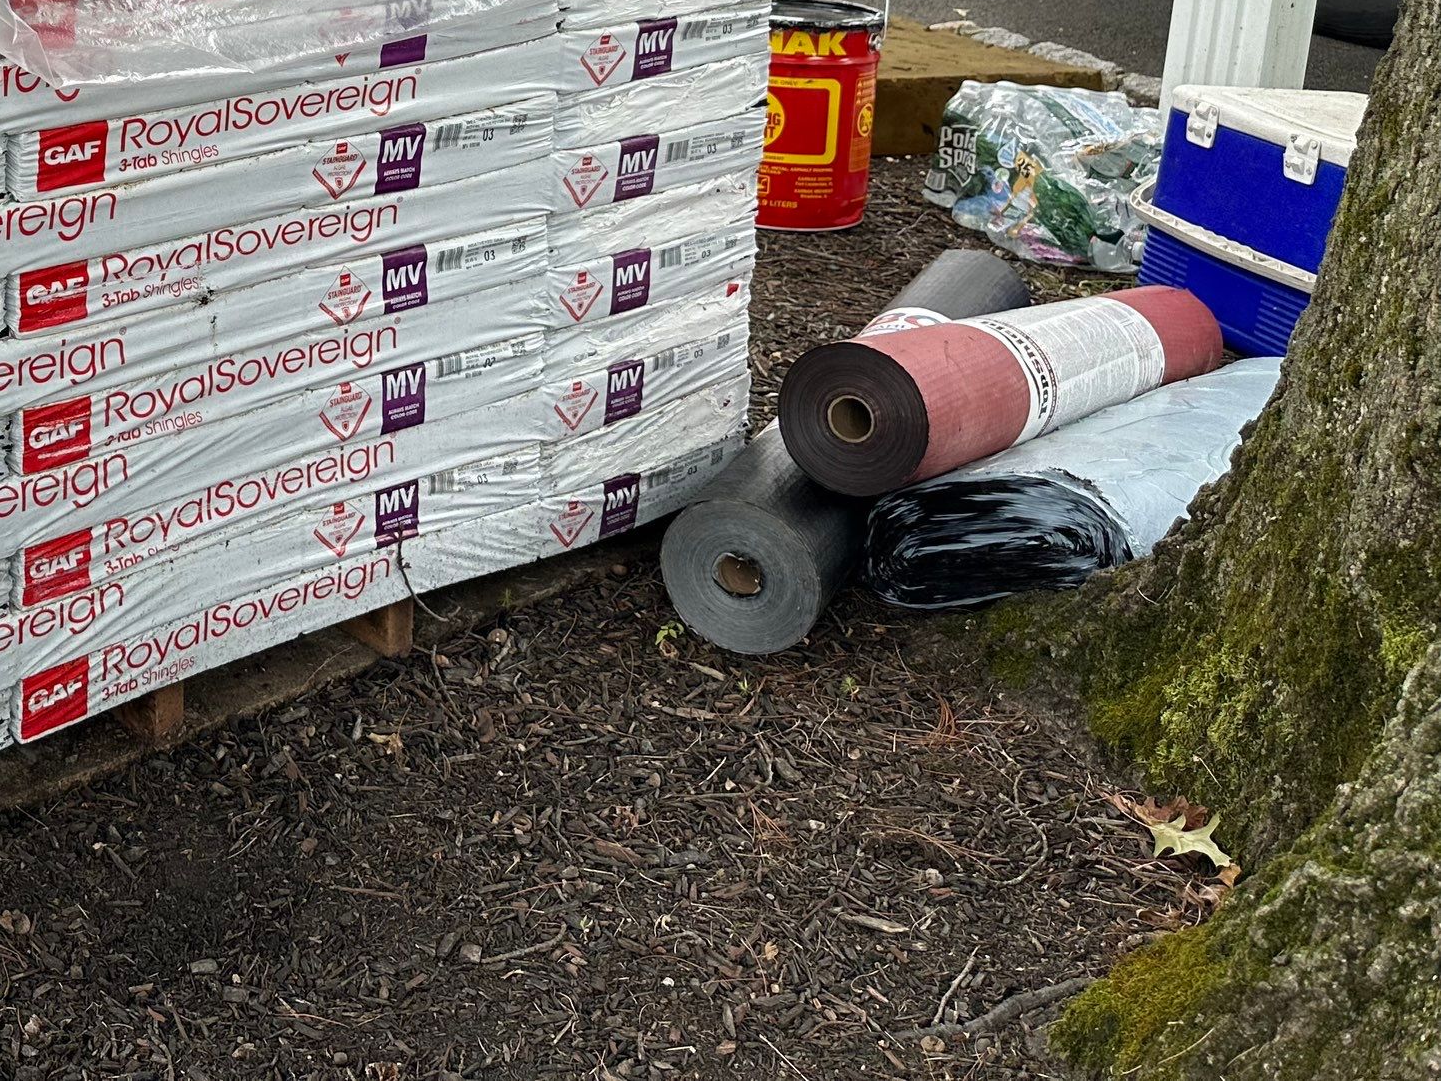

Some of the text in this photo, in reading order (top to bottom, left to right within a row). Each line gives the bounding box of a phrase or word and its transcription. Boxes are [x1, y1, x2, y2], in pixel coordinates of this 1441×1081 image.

[639, 28, 674, 54] MV
[118, 72, 416, 154] RoyalSovereign
[381, 134, 422, 163] MV
[482, 128, 494, 142] 03
[44, 142, 100, 167] GAF
[118, 142, 219, 173] 3-Tab Shingles
[622, 149, 655, 174] MV
[101, 201, 398, 285] RoyalSovereign
[483, 250, 496, 262] 03
[386, 262, 424, 292] MV
[616, 261, 648, 287] MV
[25, 275, 85, 306] GAF
[101, 288, 140, 308] 3-Tab
[102, 322, 399, 428] RoyalSovereign
[386, 368, 423, 401] MV
[610, 366, 642, 393] MV
[28, 420, 85, 450] GAF
[145, 409, 203, 435] Shingles
[102, 437, 395, 555] RoyalSovereign
[379, 485, 416, 516] MV
[606, 484, 637, 511] MV
[29, 551, 84, 580] GAF
[100, 553, 391, 682] RoyalSovereign
[101, 656, 196, 704] 3-Tab Shingles
[28, 683, 84, 714] GAF
